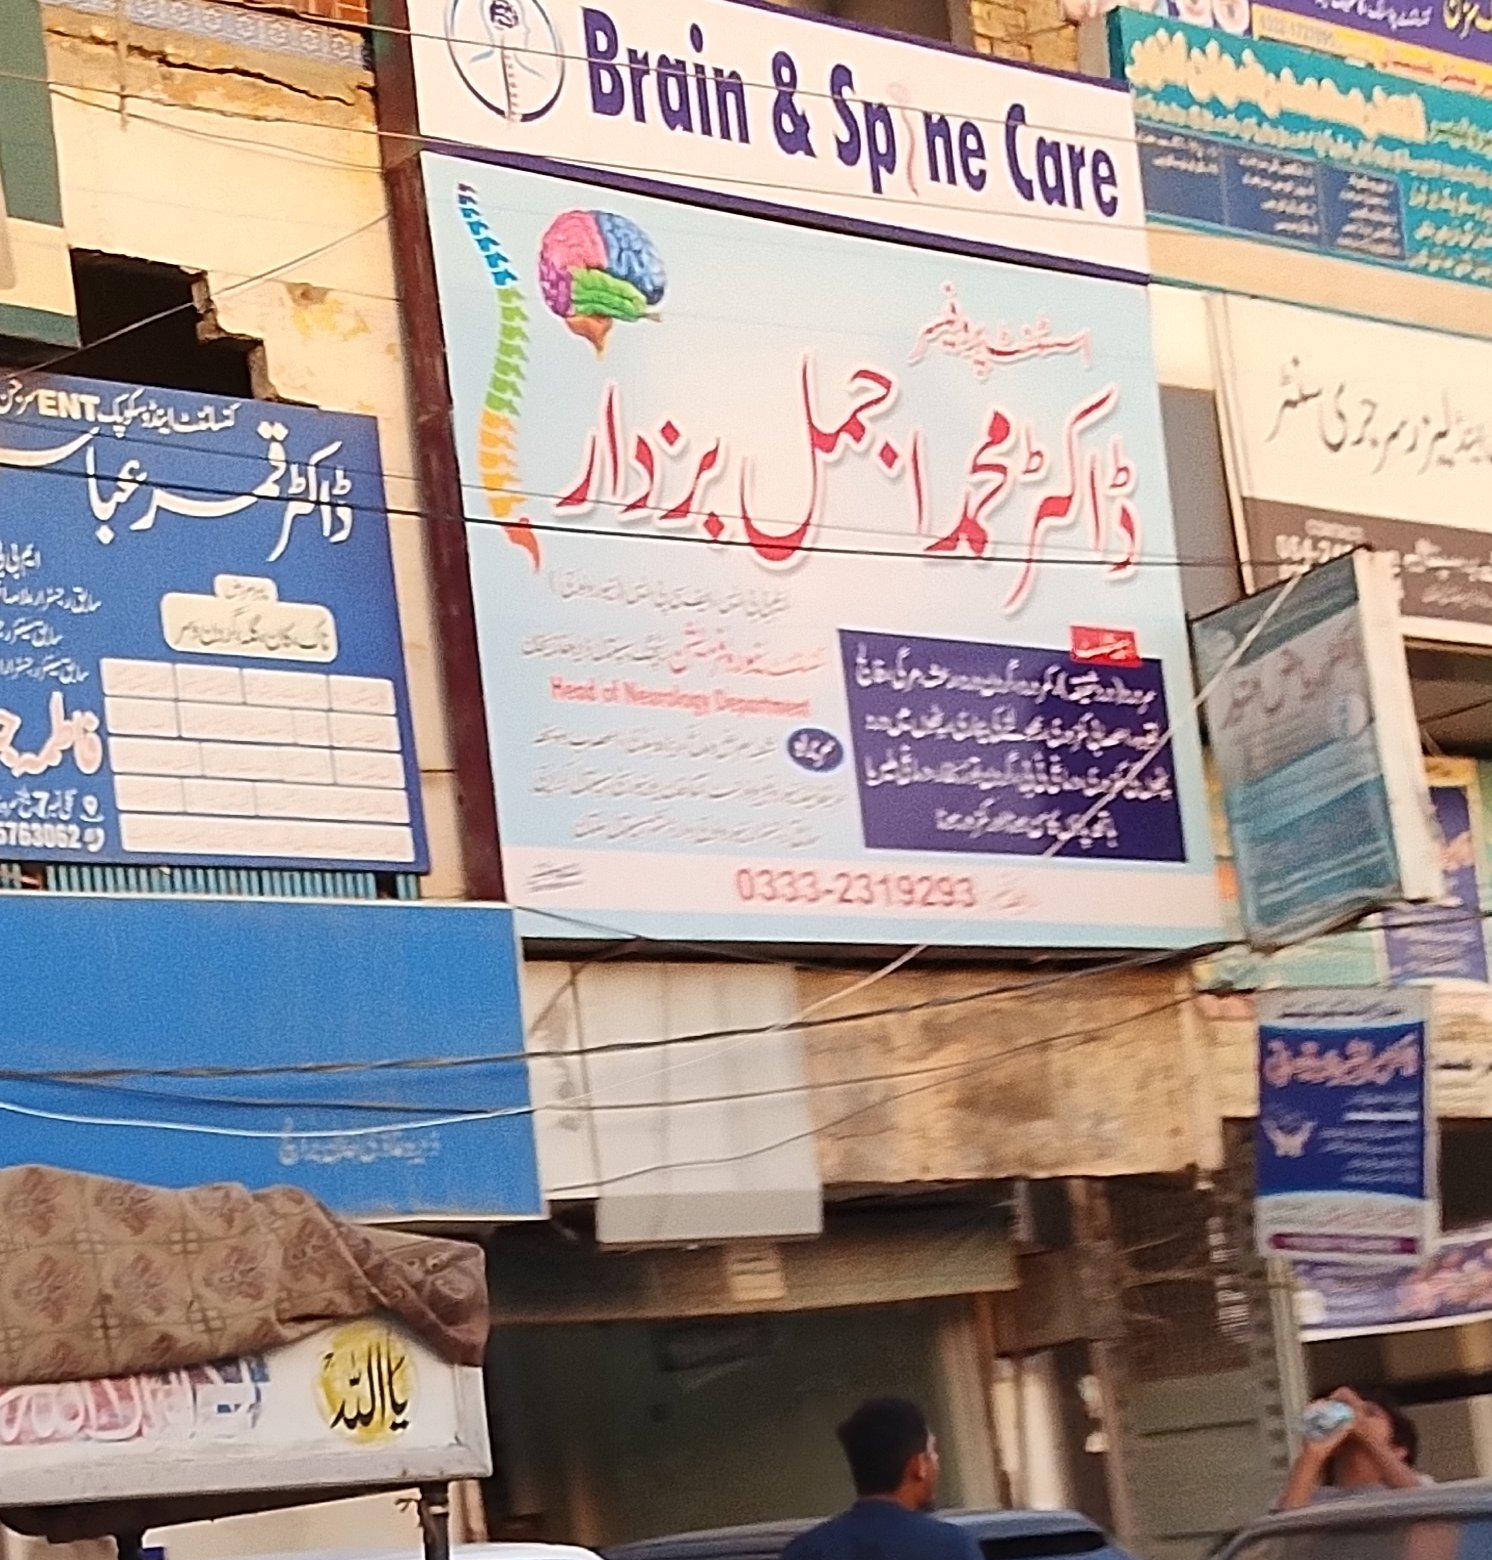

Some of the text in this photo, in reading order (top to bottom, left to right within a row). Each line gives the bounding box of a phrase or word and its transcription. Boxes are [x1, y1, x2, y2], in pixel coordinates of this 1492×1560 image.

[583, 6, 750, 145] Brain
[771, 50, 815, 158] &
[1005, 103, 1119, 219] Care
[37, 389, 100, 422] ENT
[129, 420, 289, 531] قمر
[265, 441, 352, 562] ڈاکٹر
[553, 350, 1138, 609] ڈاکٹر محمد اجمل بزدار
[551, 676, 596, 702] Head
[736, 867, 977, 909] 0333-2319293
